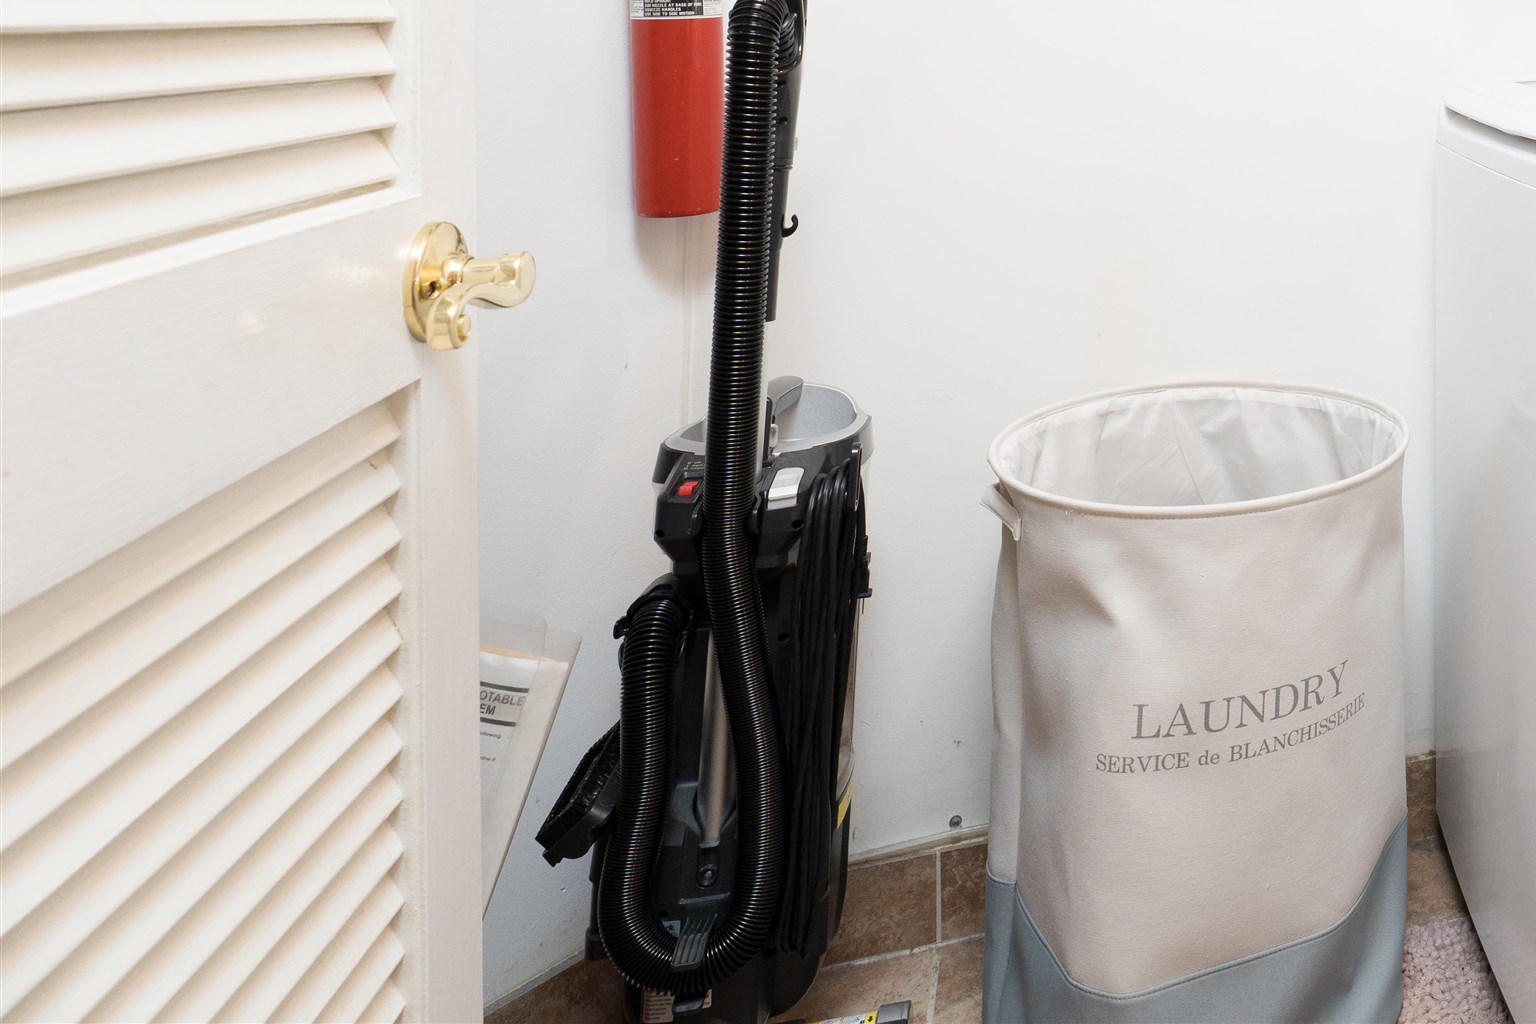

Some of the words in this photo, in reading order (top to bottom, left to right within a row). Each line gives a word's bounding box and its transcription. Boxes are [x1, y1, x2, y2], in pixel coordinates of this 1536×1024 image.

[480, 690, 526, 706] OTABLE
[1096, 750, 1190, 774] SERVICE
[1198, 749, 1221, 767] de
[1229, 692, 1366, 763] BLANCHISSERIE
[1131, 659, 1349, 740] LAUNDRY
